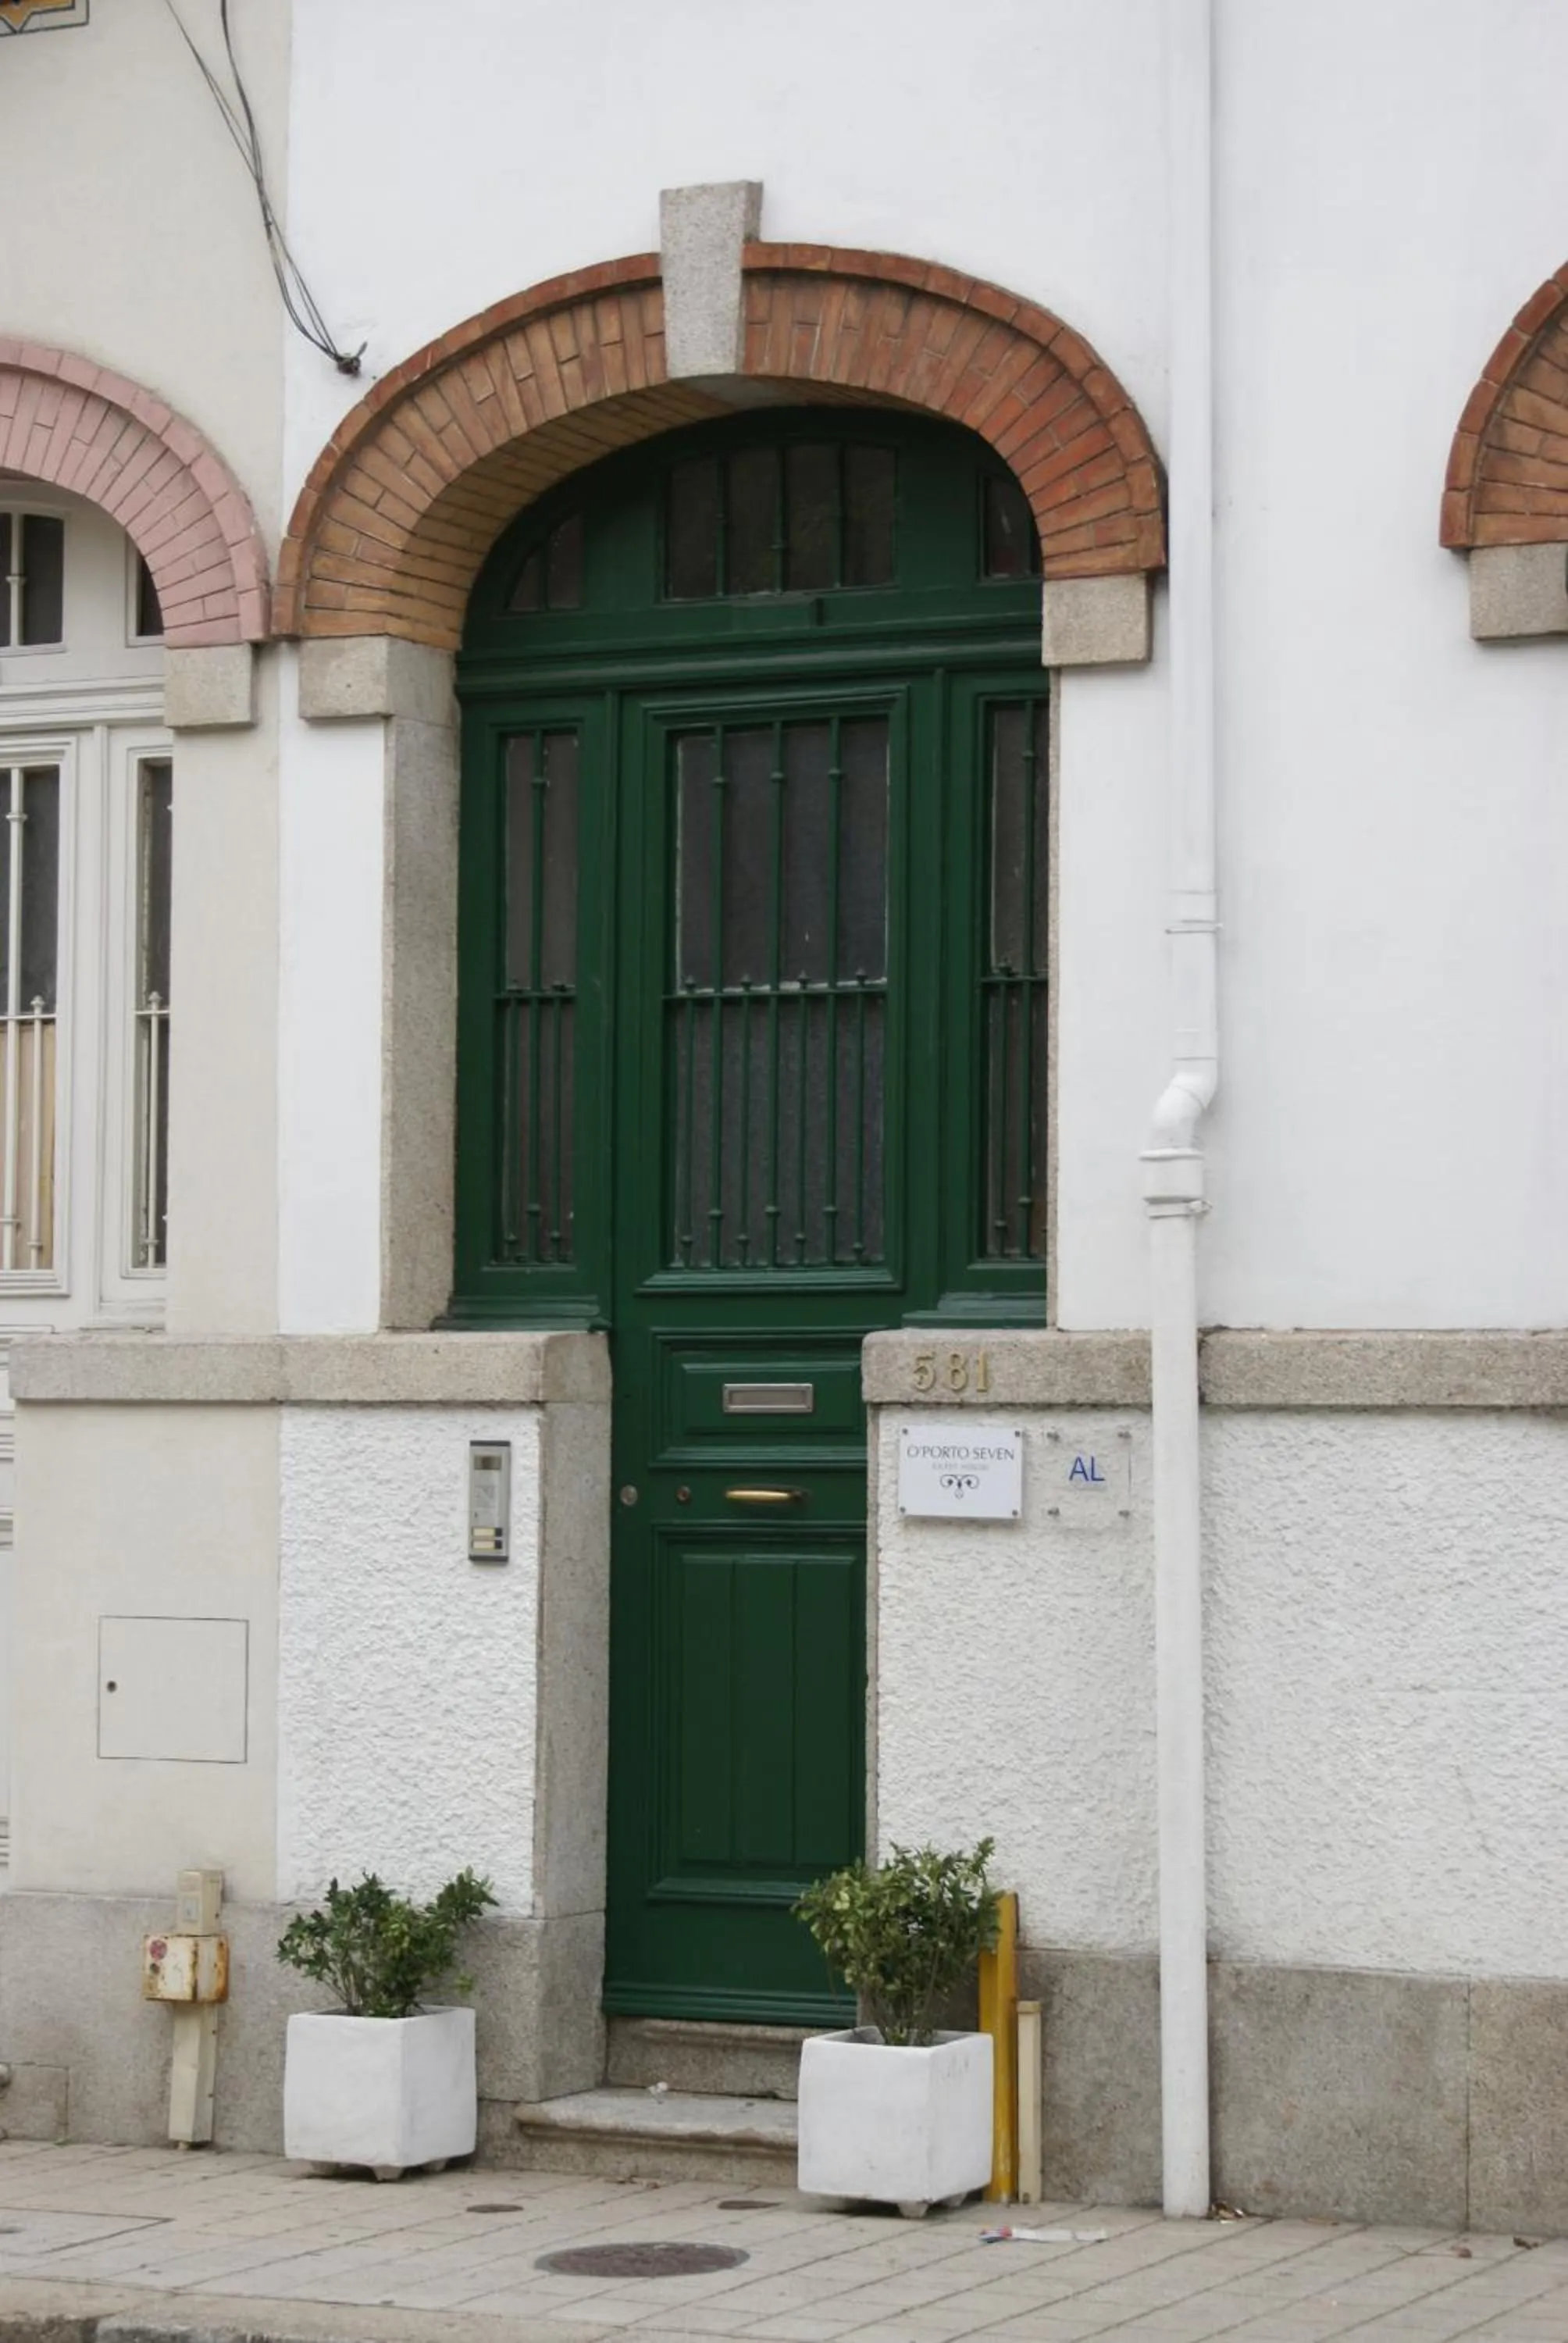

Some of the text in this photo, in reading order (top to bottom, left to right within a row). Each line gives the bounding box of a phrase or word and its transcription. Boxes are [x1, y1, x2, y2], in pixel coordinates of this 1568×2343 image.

[913, 1352, 989, 1393] 581
[972, 1447, 1015, 1460] SEVEN
[1068, 1455, 1106, 1482] AL
